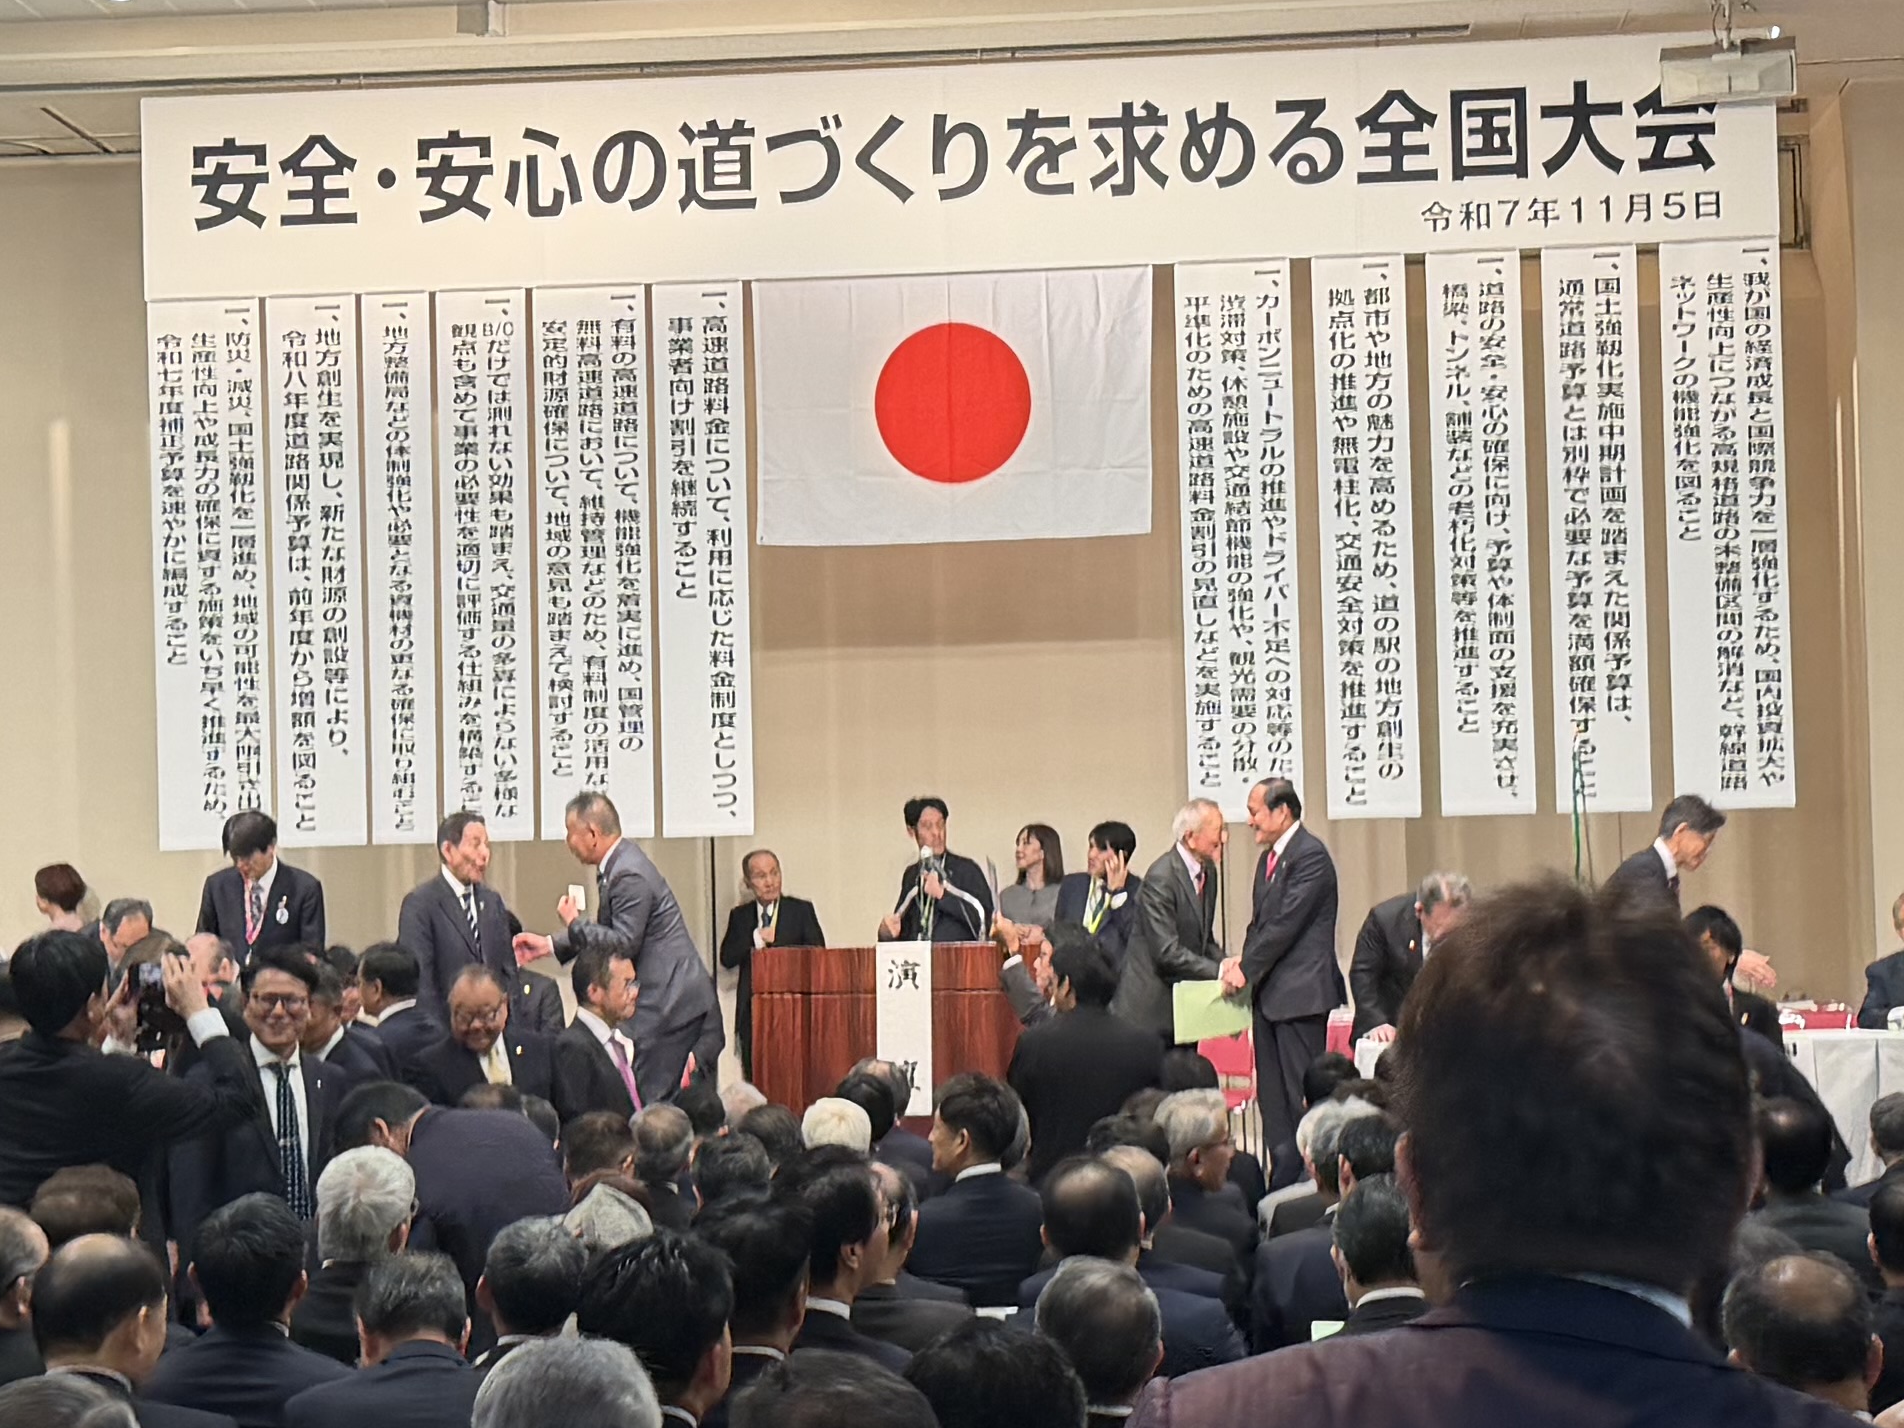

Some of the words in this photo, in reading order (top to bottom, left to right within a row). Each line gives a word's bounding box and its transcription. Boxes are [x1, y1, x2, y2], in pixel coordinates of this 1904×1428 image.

[192, 81, 1718, 232] 安全・安心の道づくりを求める全国大会
[1419, 189, 1726, 234] 令和7年11月5日
[450, 323, 484, 815] 観点も含めて事業の必要性を適切に評価する仕組みを構築するこ
[576, 320, 609, 791] 無料高速道路において、維持管理などのため、有料制度の活用な
[668, 316, 698, 600] 事業者向け割引を継続すること
[1254, 269, 1294, 780] 一、カーボンニュートラルの推進やドライバー不足への対応等のた
